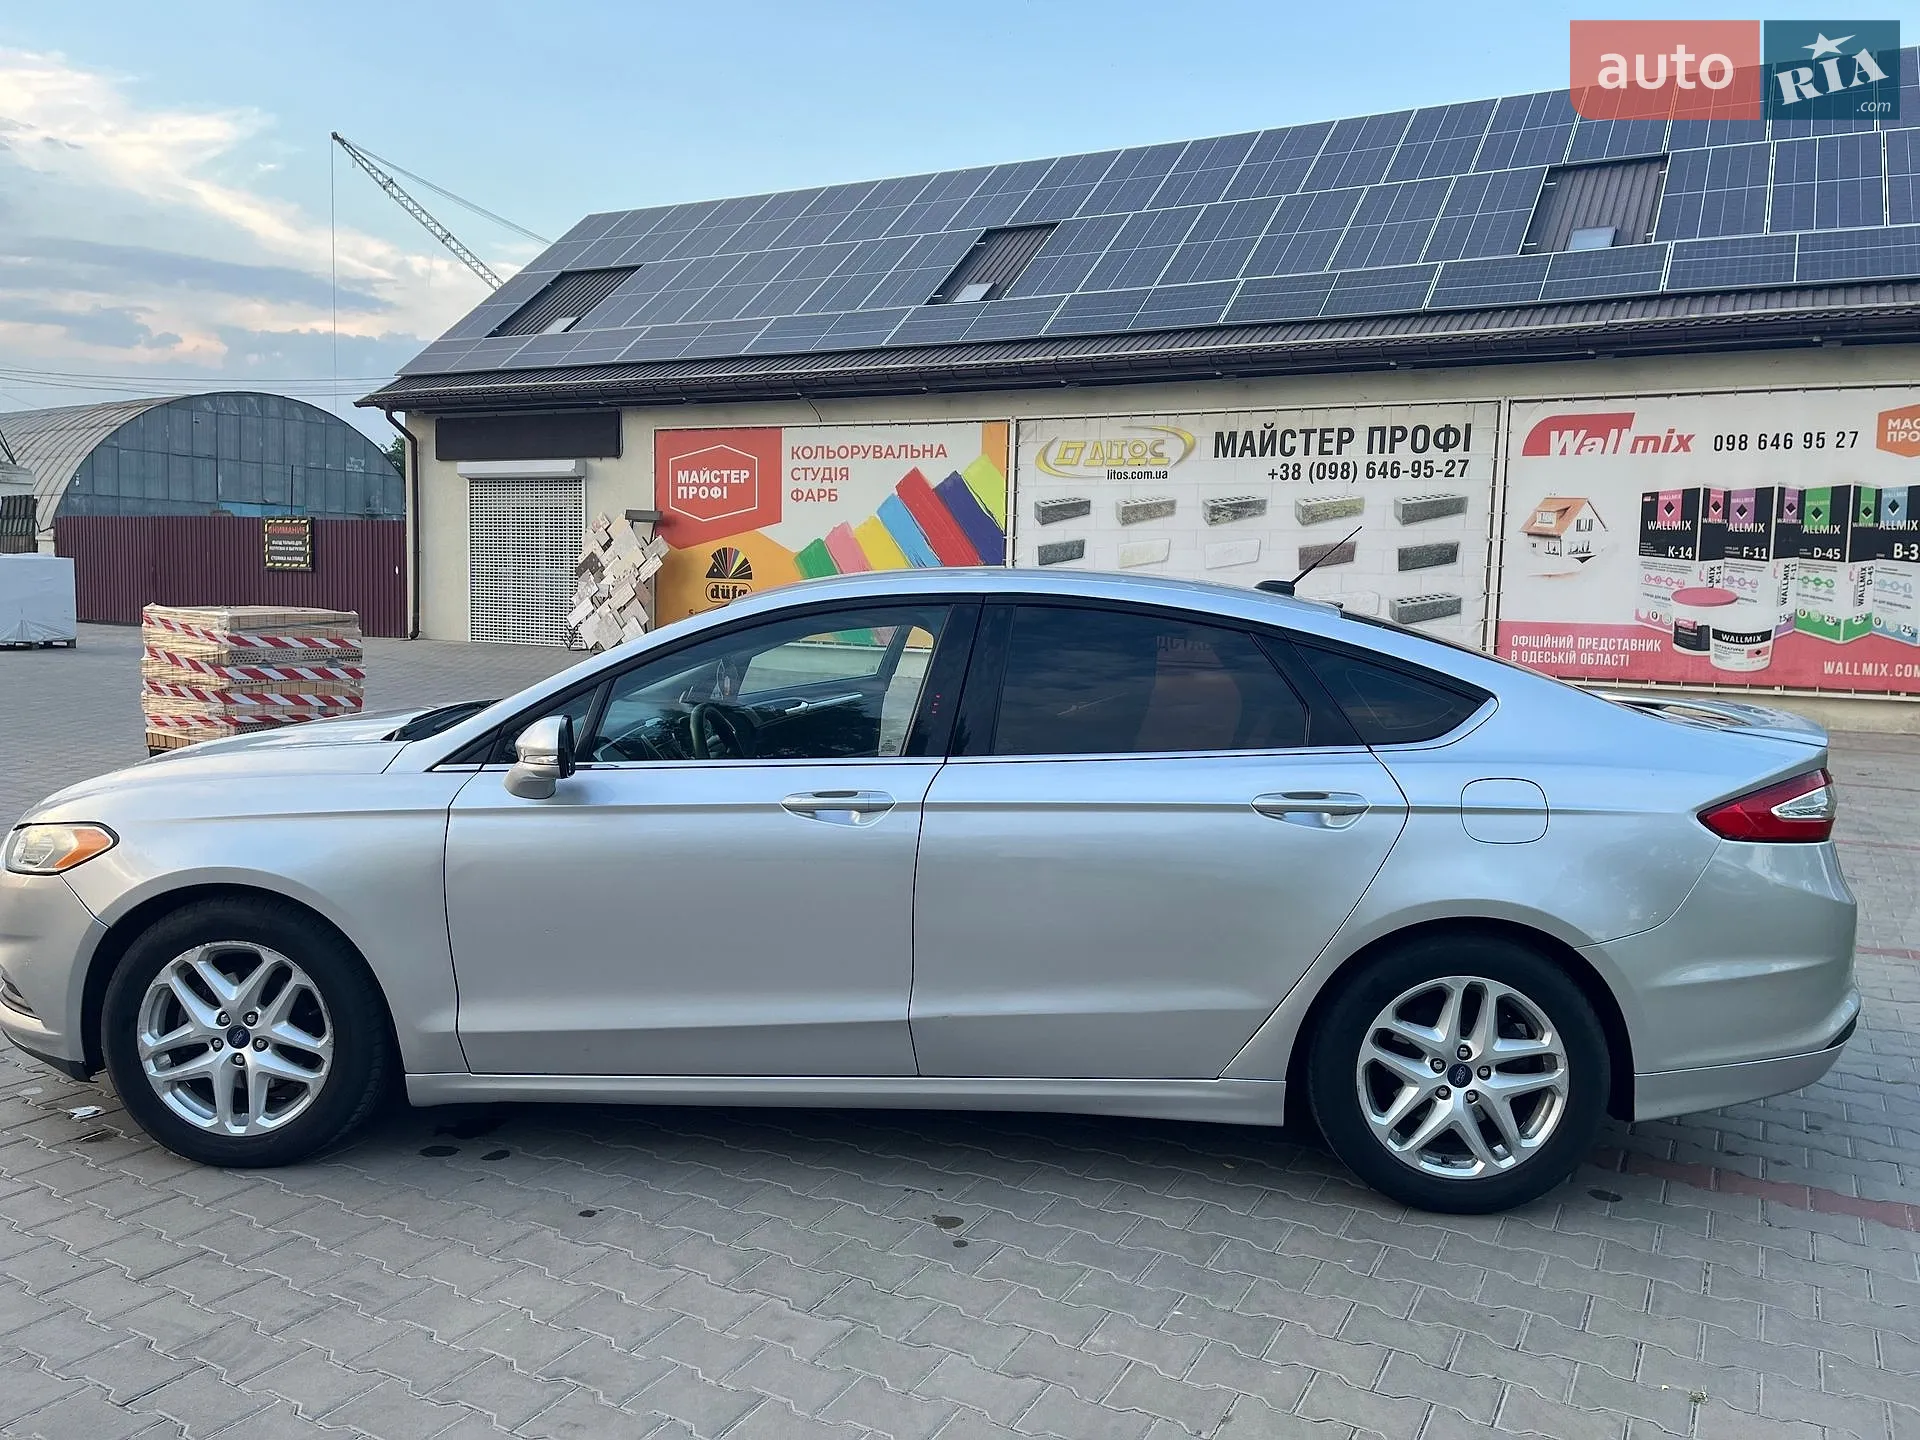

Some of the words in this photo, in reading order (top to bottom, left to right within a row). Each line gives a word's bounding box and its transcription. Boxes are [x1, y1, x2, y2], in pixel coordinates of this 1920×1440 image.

[1213, 422, 1356, 459] МАЙСТЕР
[1366, 422, 1473, 456] ПРОФІ
[1549, 427, 1631, 456] Wall
[1629, 427, 1697, 455] mix
[1713, 433, 1749, 452] 098
[1757, 432, 1794, 450] 646
[1802, 431, 1827, 449] 95
[1835, 430, 1859, 449] 27
[790, 443, 949, 460] КОЛЬОРУВАЛЬНА
[677, 466, 750, 484] МАЙСТЕР
[790, 466, 850, 484] СТУДІЯ
[1106, 468, 1169, 481] litos.com.ua
[1267, 462, 1302, 481] +38
[1308, 460, 1359, 484] (098)
[1365, 458, 1471, 480] 646-95-27
[677, 485, 728, 500] ПРОФІ
[790, 487, 839, 503] ФАРБ
[1647, 520, 1692, 531] WALLMIX
[1726, 522, 1766, 534] ALLMIX
[1801, 524, 1841, 535] ALLMIX
[1878, 519, 1919, 531] ALLMIX
[1667, 545, 1694, 560] K-14
[1742, 546, 1768, 560] F-11
[1813, 547, 1841, 560] D-45
[1892, 542, 1920, 561] B-3
[1511, 633, 1574, 650] ОФІЦІЙНИЙ
[1577, 636, 1662, 653] ПРЕДСТАВНИК
[1721, 632, 1762, 644] WALLMIX
[1511, 650, 1518, 663] В
[1521, 649, 1577, 665] ОДЕСЬКІЙ
[1579, 652, 1630, 667] ОБЛАСТІ
